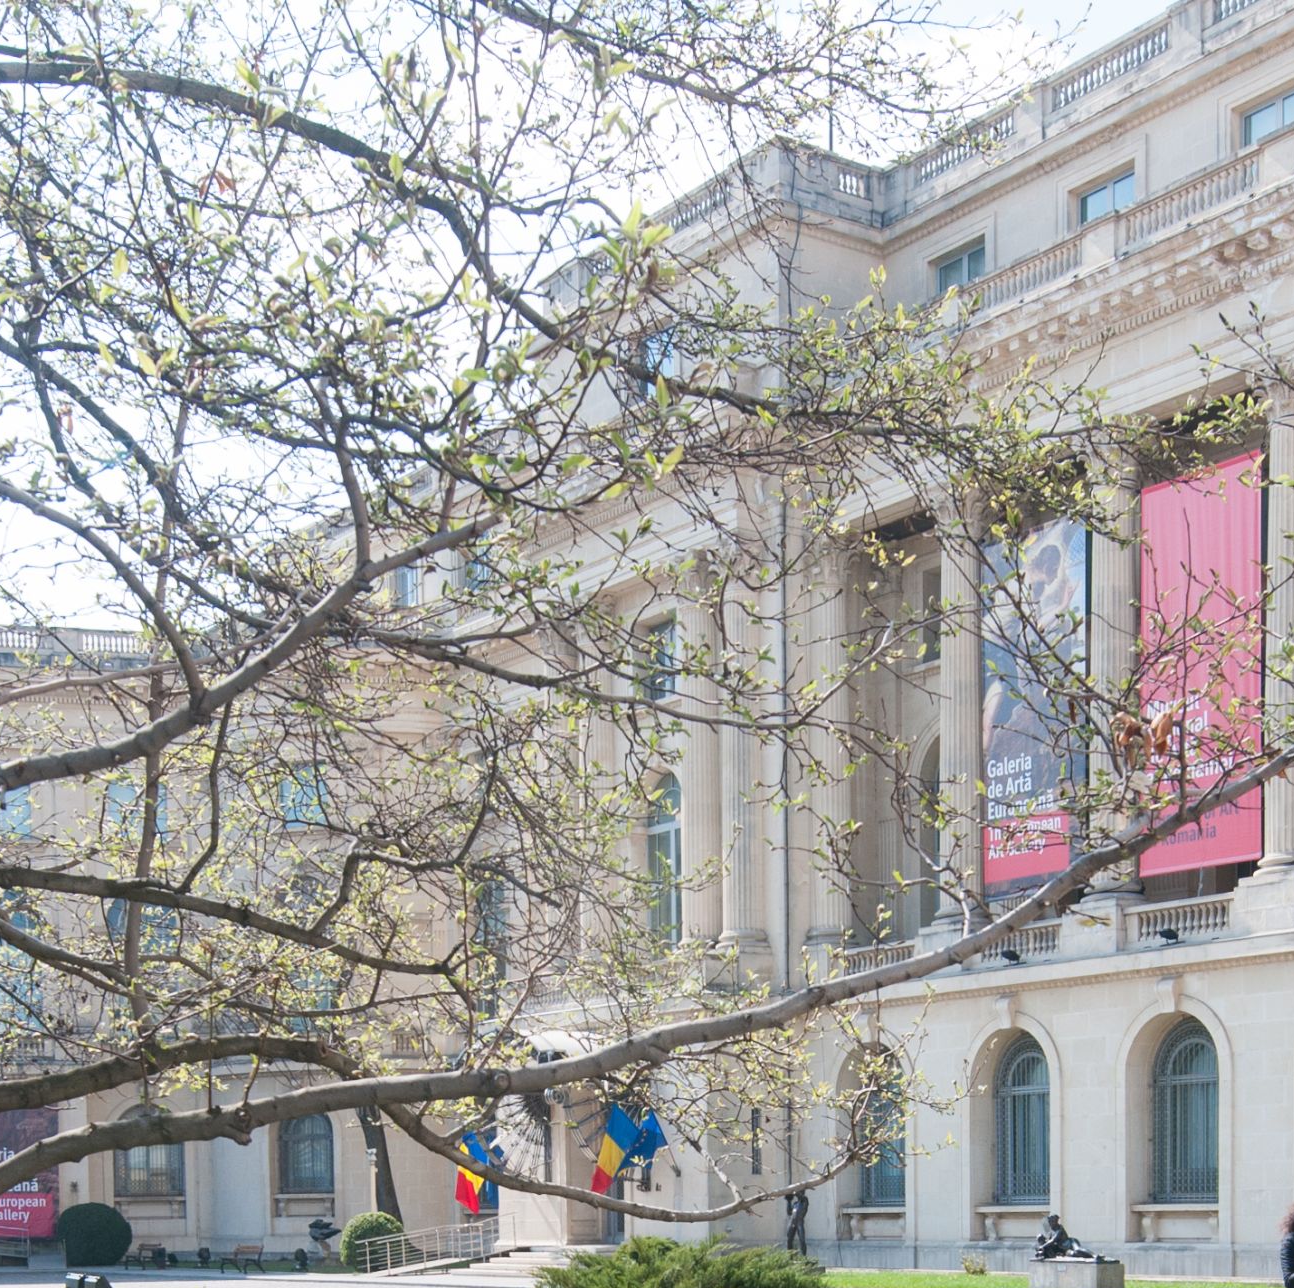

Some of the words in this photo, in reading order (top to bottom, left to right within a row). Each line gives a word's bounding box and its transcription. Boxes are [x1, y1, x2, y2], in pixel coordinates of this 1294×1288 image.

[987, 752, 1032, 778] Galeria
[987, 780, 1003, 799] de
[1005, 771, 1032, 796] Artă
